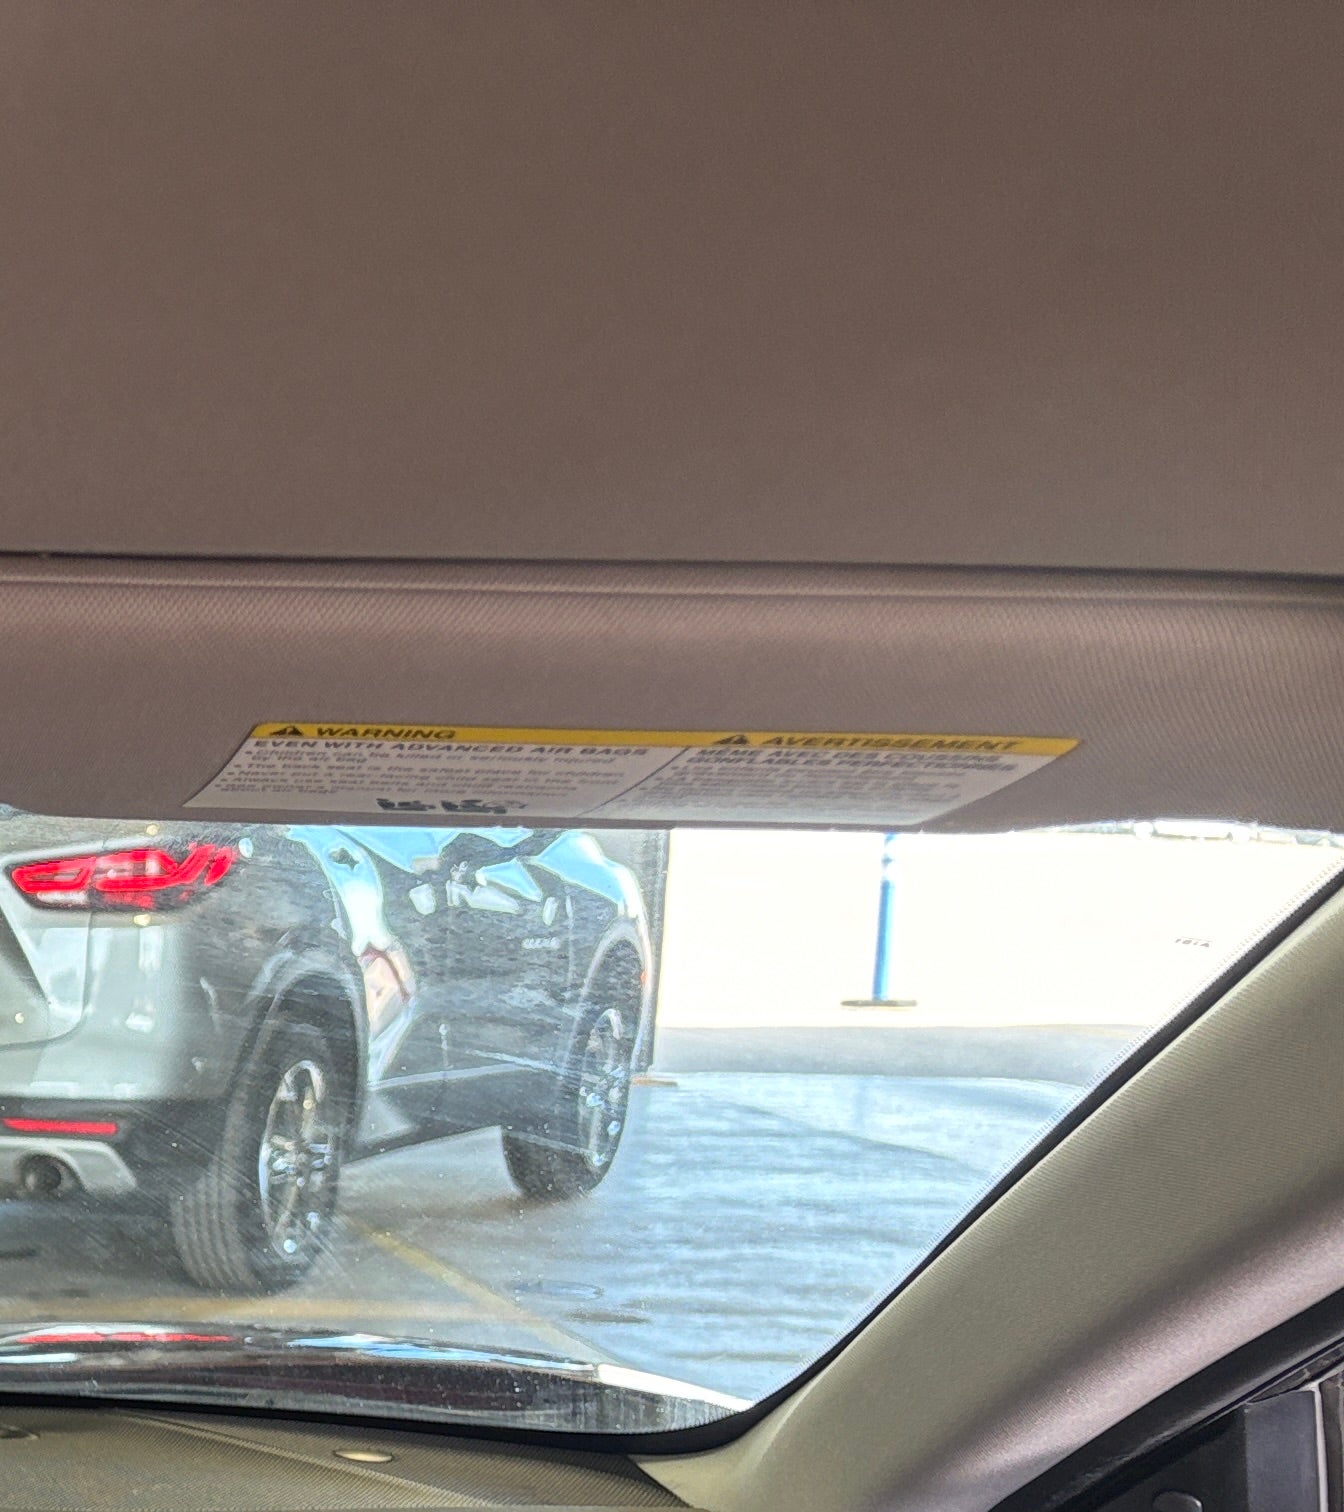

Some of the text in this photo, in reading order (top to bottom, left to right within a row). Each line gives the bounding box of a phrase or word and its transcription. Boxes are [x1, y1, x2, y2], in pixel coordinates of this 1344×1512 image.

[317, 727, 456, 739] WARNING
[324, 742, 385, 750] WITH
[391, 743, 524, 753] ADVANCED
[531, 746, 574, 754] AIR
[579, 748, 649, 756] BAGS
[761, 736, 1023, 750] AVERTISSEMENT
